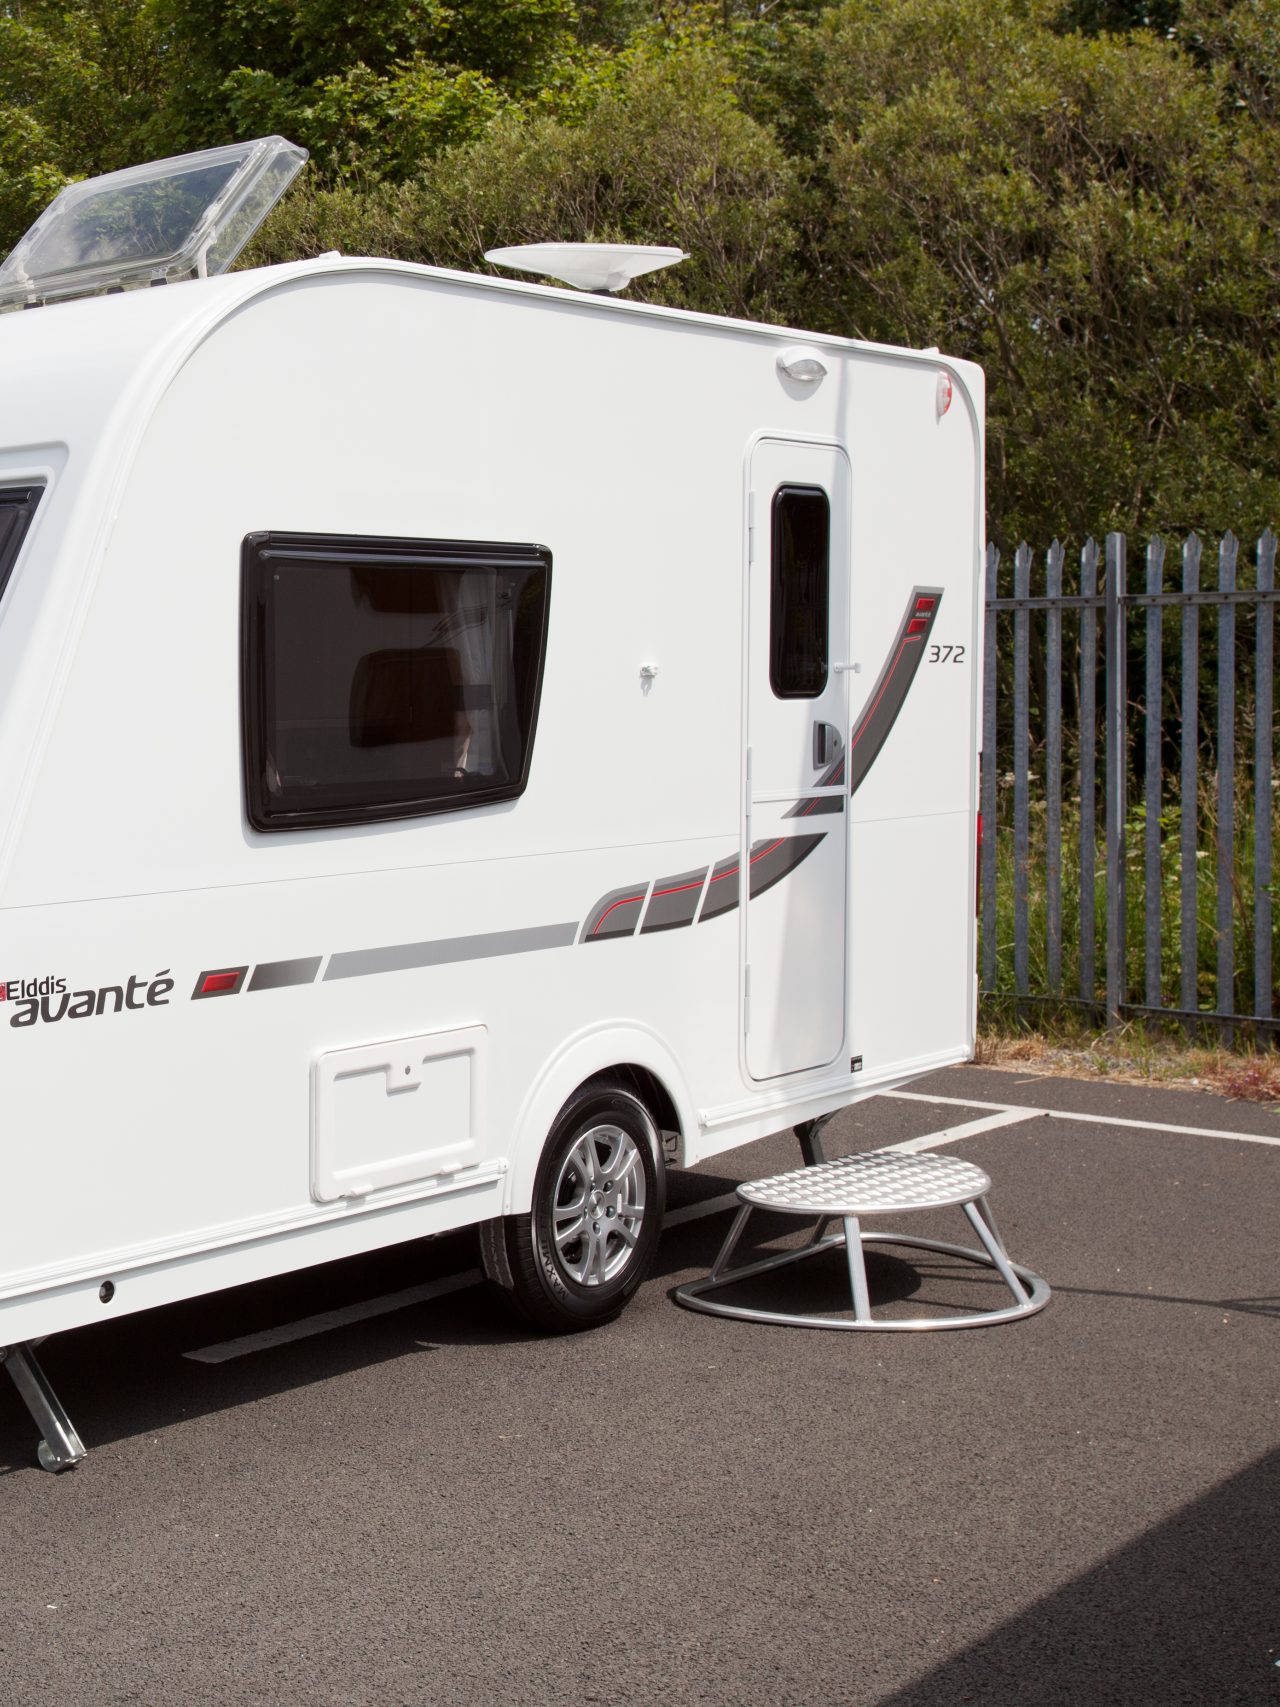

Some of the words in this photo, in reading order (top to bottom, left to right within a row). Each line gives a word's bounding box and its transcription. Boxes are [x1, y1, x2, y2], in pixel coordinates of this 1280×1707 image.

[929, 645, 965, 663] 372
[6, 975, 67, 1001] Elddis
[9, 968, 175, 1028] avanté
